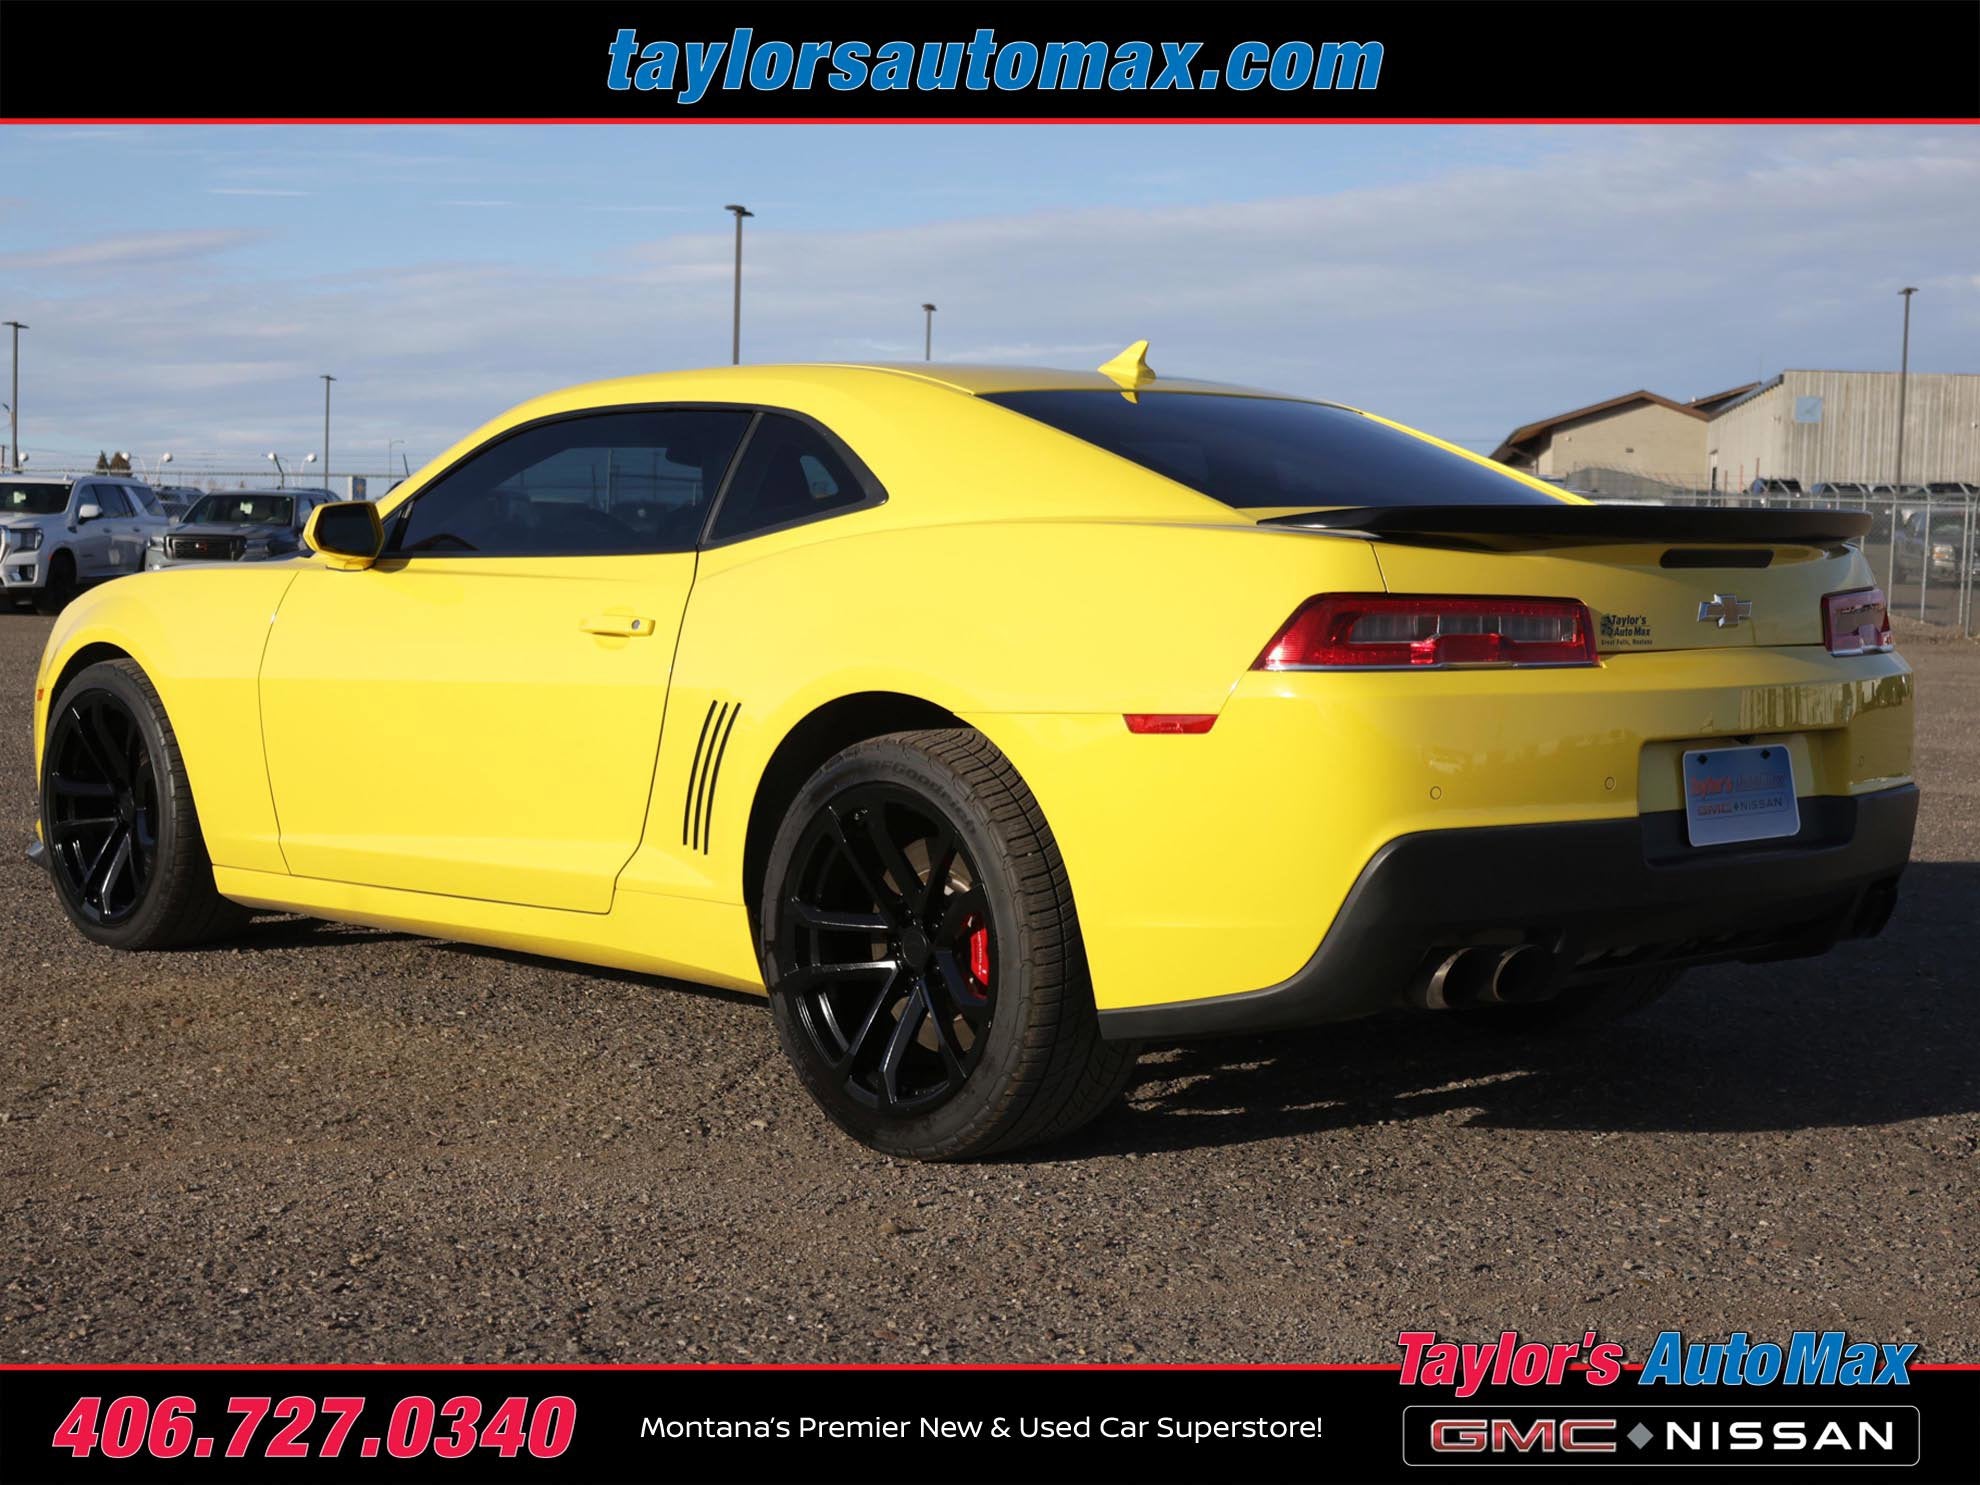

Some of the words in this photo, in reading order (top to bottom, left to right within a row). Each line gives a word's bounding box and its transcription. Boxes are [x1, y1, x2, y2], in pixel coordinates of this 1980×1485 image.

[1611, 615, 1647, 627] Taylor's
[1614, 627, 1633, 637] Auto
[1634, 626, 1651, 637] Max
[1740, 797, 1783, 811] NISSAN
